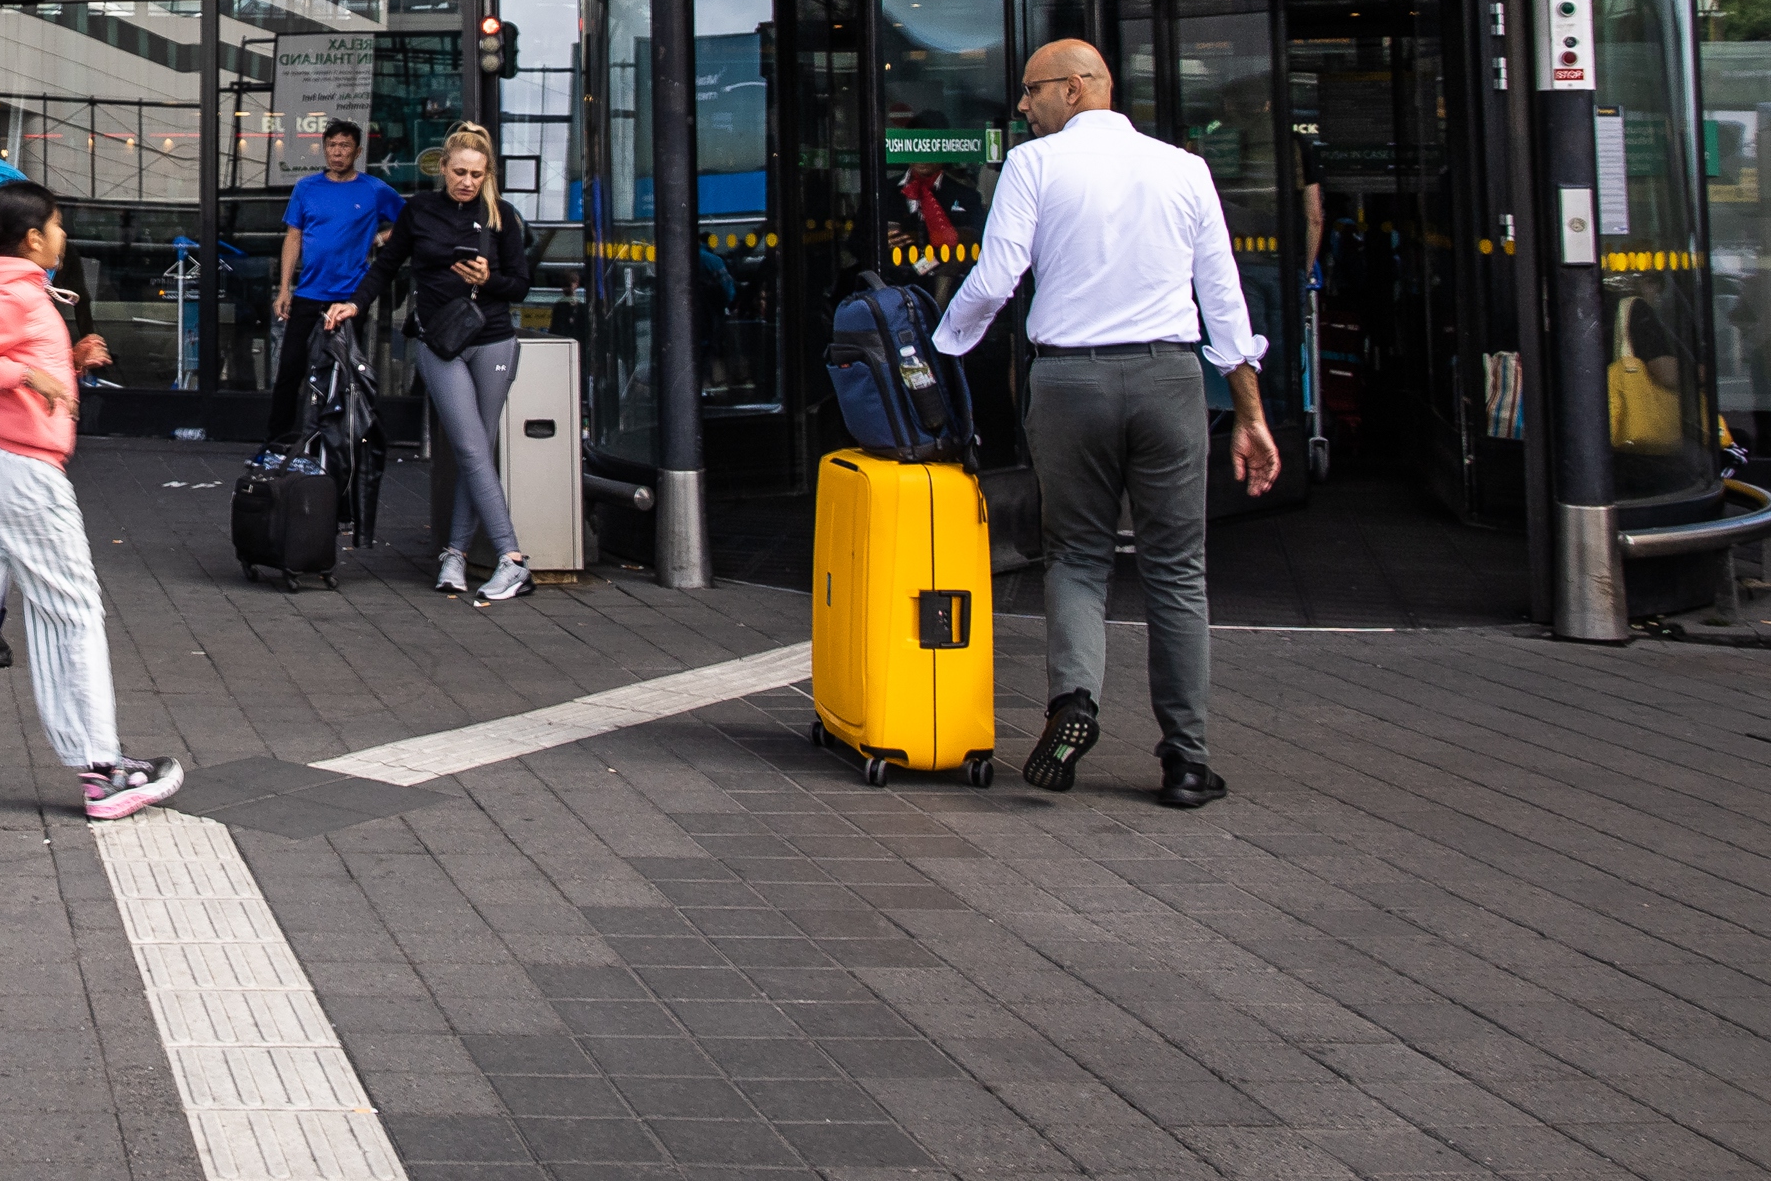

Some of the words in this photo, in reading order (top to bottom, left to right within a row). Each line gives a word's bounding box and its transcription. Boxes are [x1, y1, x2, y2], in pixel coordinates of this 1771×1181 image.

[1555, 69, 1584, 79] STOP
[261, 116, 328, 133] BURGE
[904, 138, 913, 152] IN
[913, 138, 931, 152] CASE
[931, 138, 941, 152] OF
[941, 138, 982, 152] EMERGENCY
